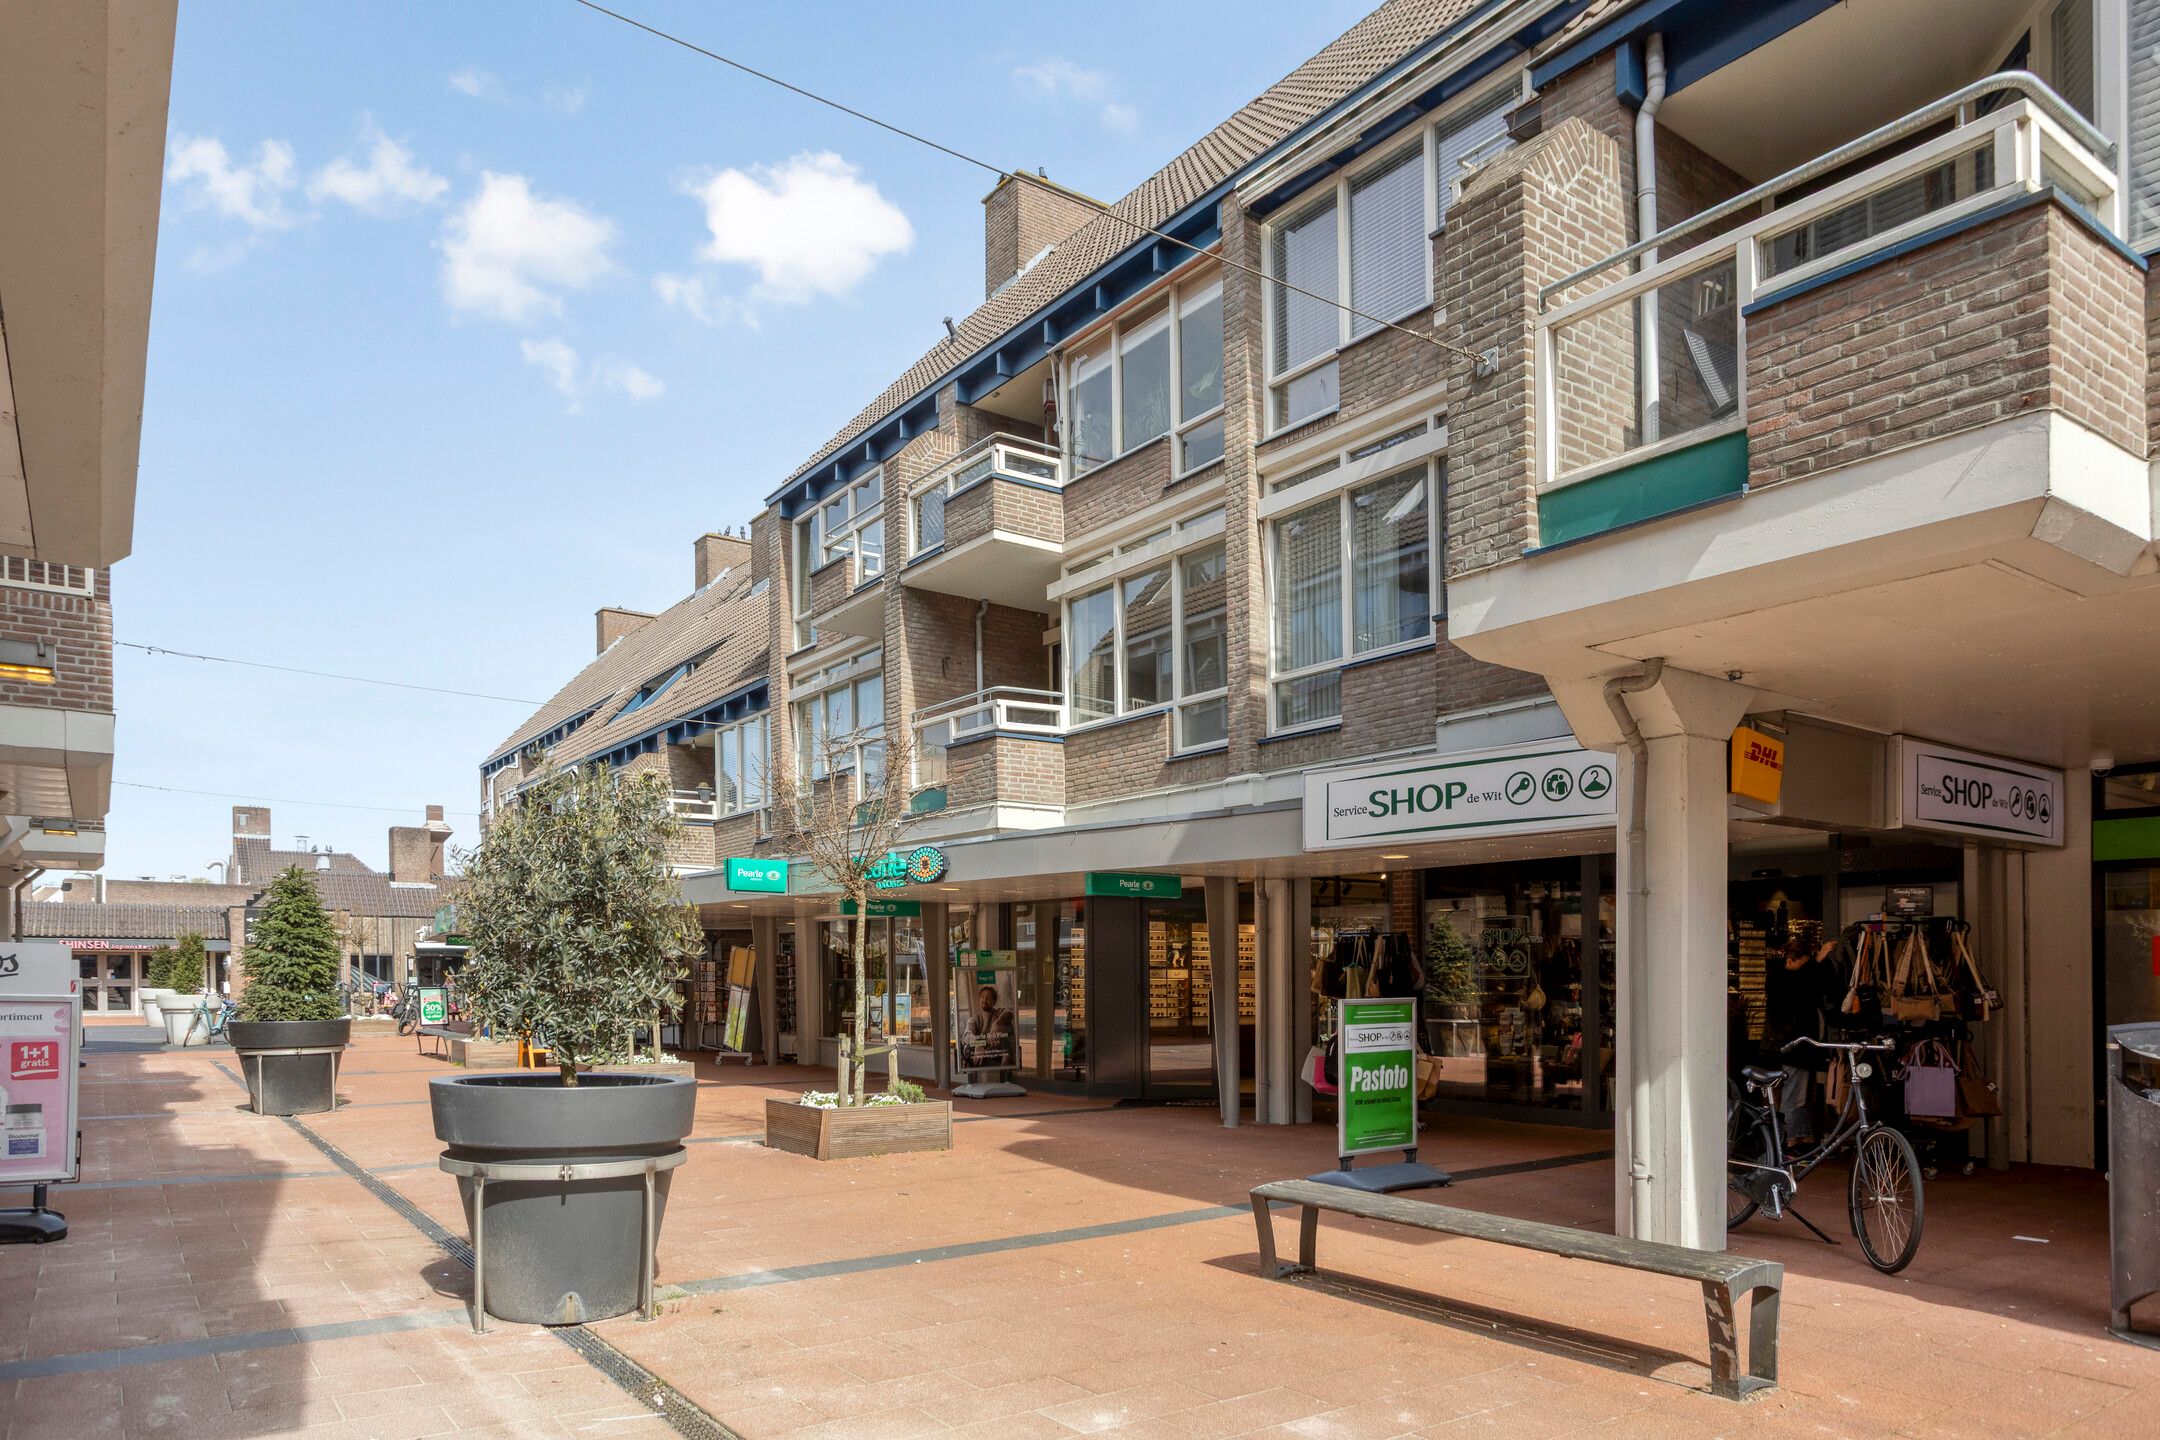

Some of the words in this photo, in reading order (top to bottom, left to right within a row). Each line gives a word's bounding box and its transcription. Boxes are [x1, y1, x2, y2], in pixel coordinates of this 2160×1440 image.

[1750, 741, 1779, 768] DHL
[1333, 805, 1368, 817] Service
[1368, 781, 1468, 818] SHOP
[1466, 794, 1480, 804] de
[1482, 791, 1503, 802] Wit
[1920, 784, 1942, 798] Service
[1941, 775, 1993, 810] SHOP
[1991, 798, 1999, 808] de
[737, 868, 764, 878] Pearle
[1119, 879, 1141, 888] Pearle
[866, 903, 885, 911] Pearle
[1482, 927, 1521, 944] SHOP
[1358, 1033, 1382, 1043] SHOP
[20, 1045, 49, 1060] 1+1
[20, 1059, 50, 1070] gratis
[1350, 1064, 1408, 1093] Pasfoto
